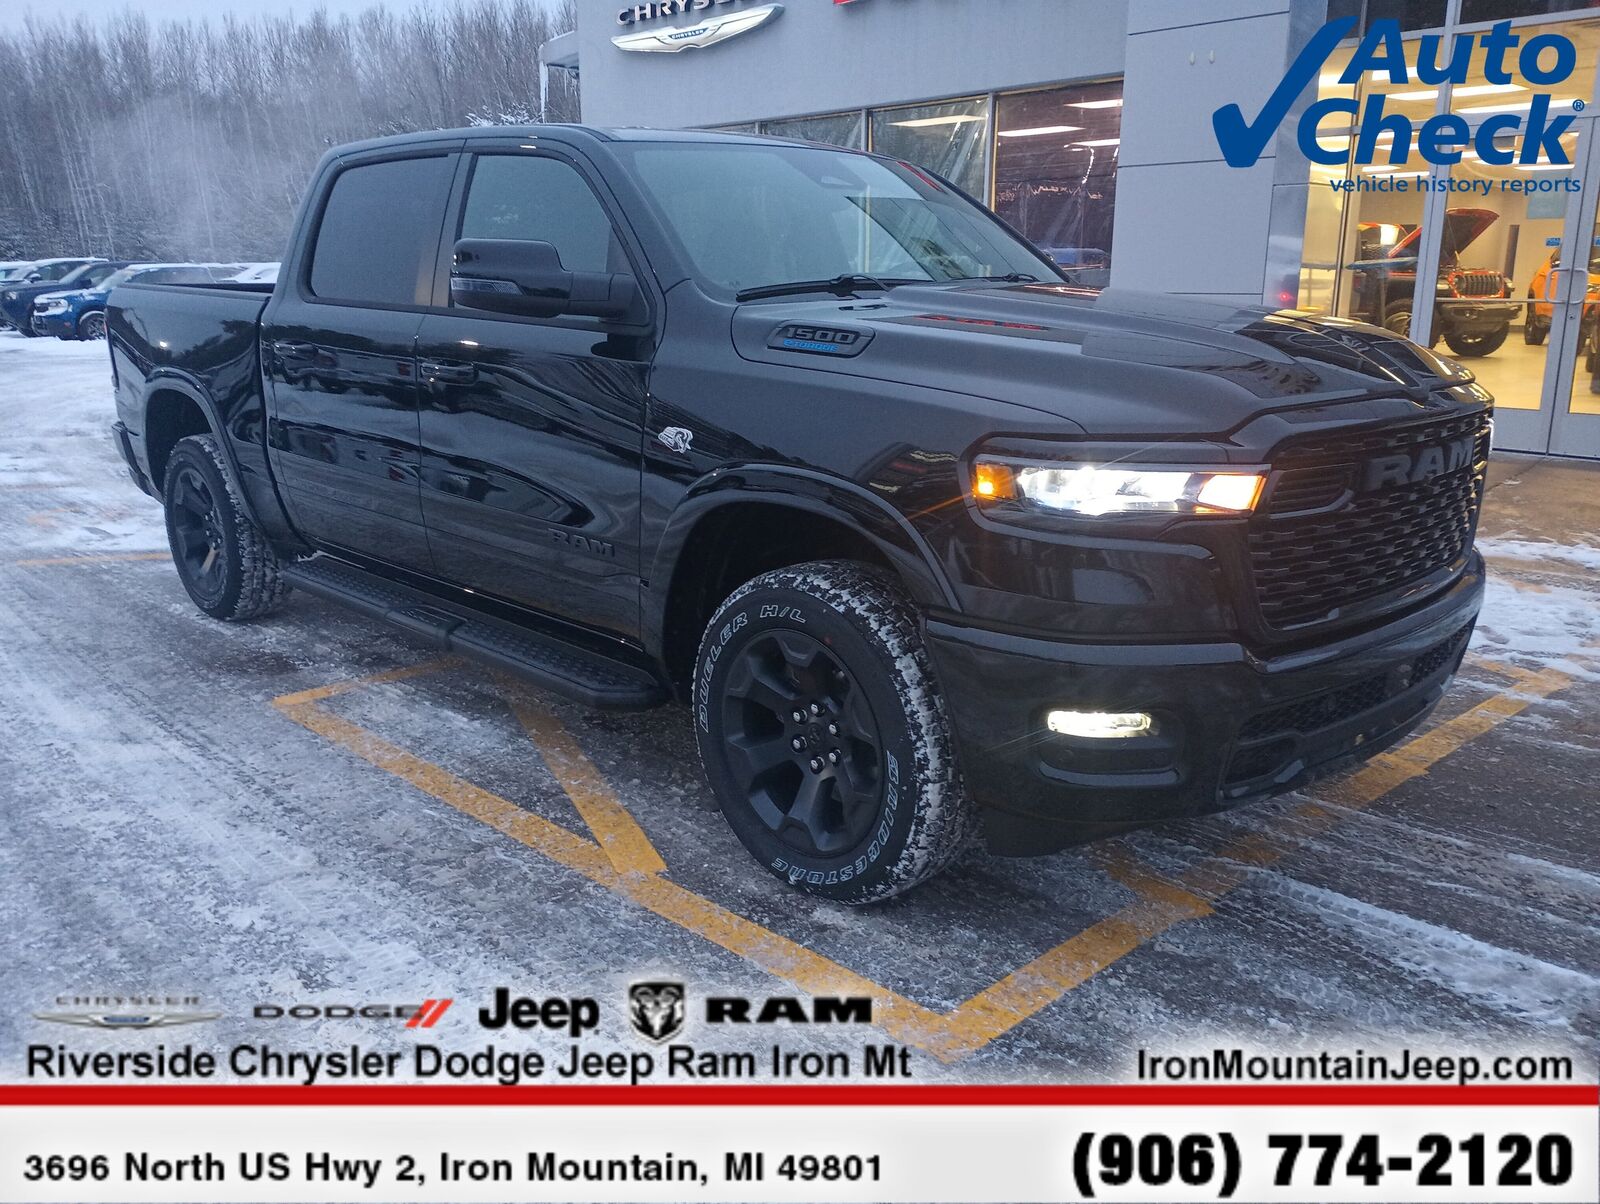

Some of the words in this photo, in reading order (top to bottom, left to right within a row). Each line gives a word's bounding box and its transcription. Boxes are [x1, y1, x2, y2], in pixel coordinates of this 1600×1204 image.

[616, 0, 736, 25] CHRYS
[786, 326, 856, 344] 1500
[1364, 434, 1476, 491] RAM
[547, 527, 615, 558] RAM
[698, 611, 748, 733] DUELER
[759, 604, 806, 624] H/L
[771, 750, 899, 886] BRIDGESTONE
